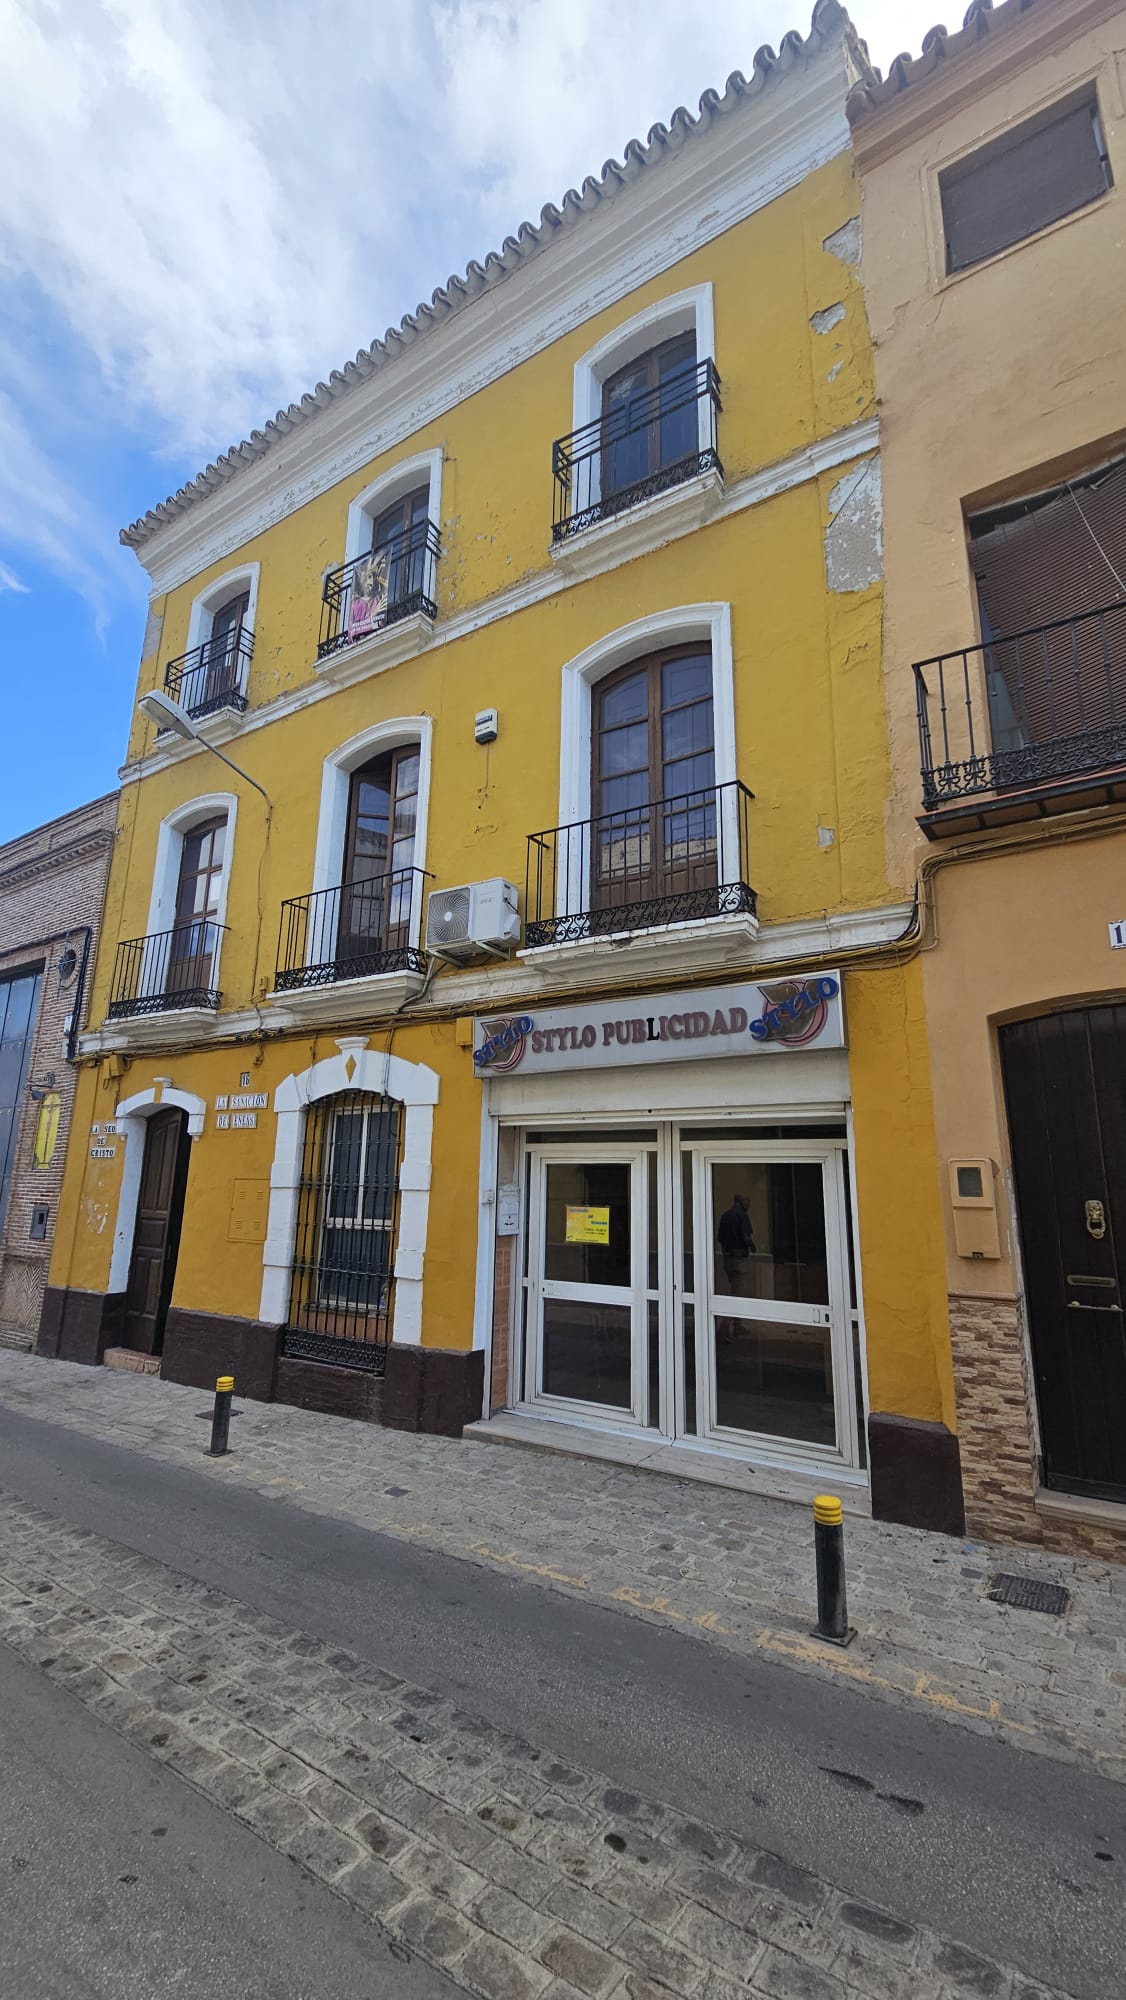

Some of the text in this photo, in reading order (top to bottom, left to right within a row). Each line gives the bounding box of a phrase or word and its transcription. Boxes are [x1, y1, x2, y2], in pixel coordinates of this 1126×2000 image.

[532, 1007, 748, 1053] STYLO PUBLICIDAD
[749, 977, 839, 1041] STYLO
[473, 1016, 533, 1067] STYLO
